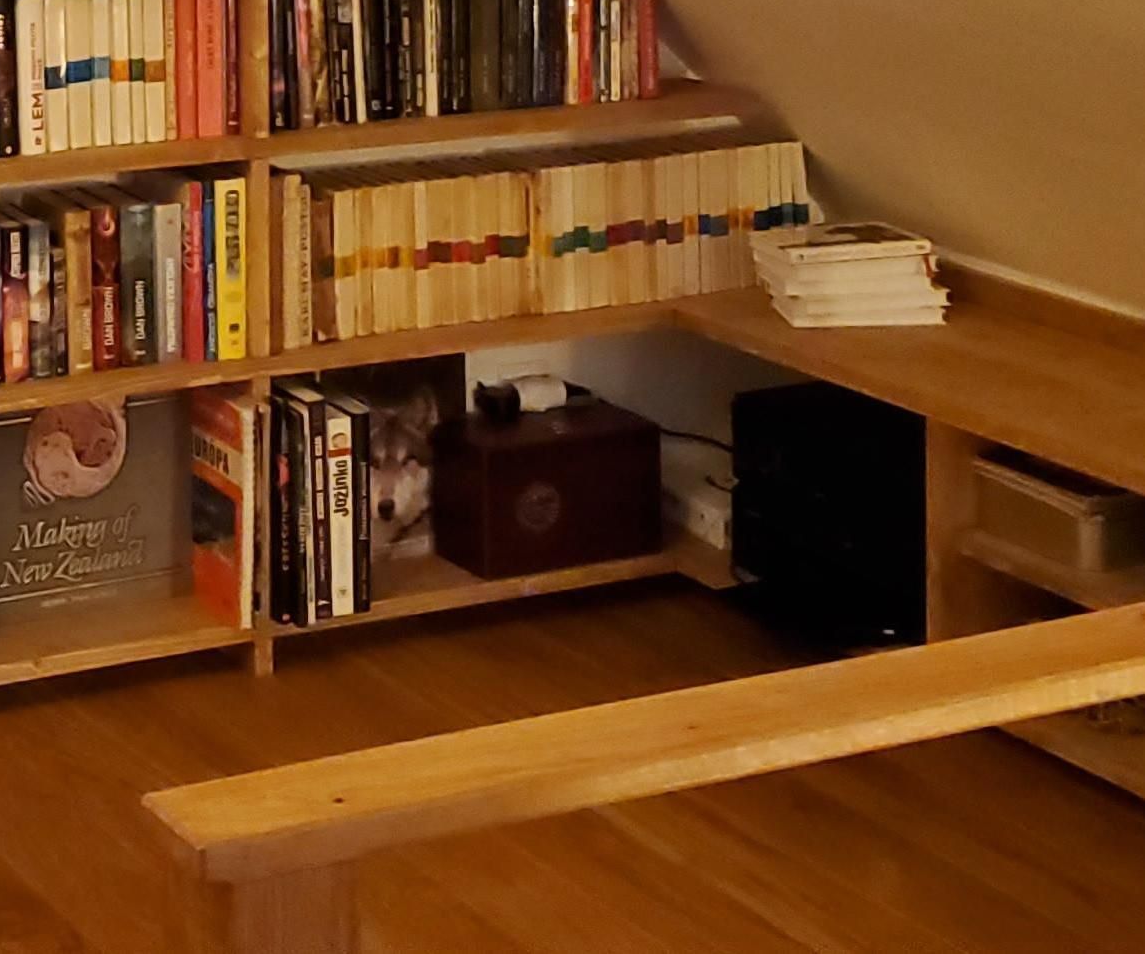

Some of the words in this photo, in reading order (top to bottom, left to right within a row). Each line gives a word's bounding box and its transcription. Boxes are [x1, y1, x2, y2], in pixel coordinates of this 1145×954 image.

[30, 92, 44, 133] LEM
[101, 286, 115, 323] BROWN
[133, 280, 146, 317] BROWN
[103, 324, 115, 346] DAN
[133, 318, 146, 340] DAN
[333, 458, 351, 519] Jožinko
[11, 515, 108, 551] Making
[110, 502, 141, 544] of
[53, 538, 145, 583] Zealand
